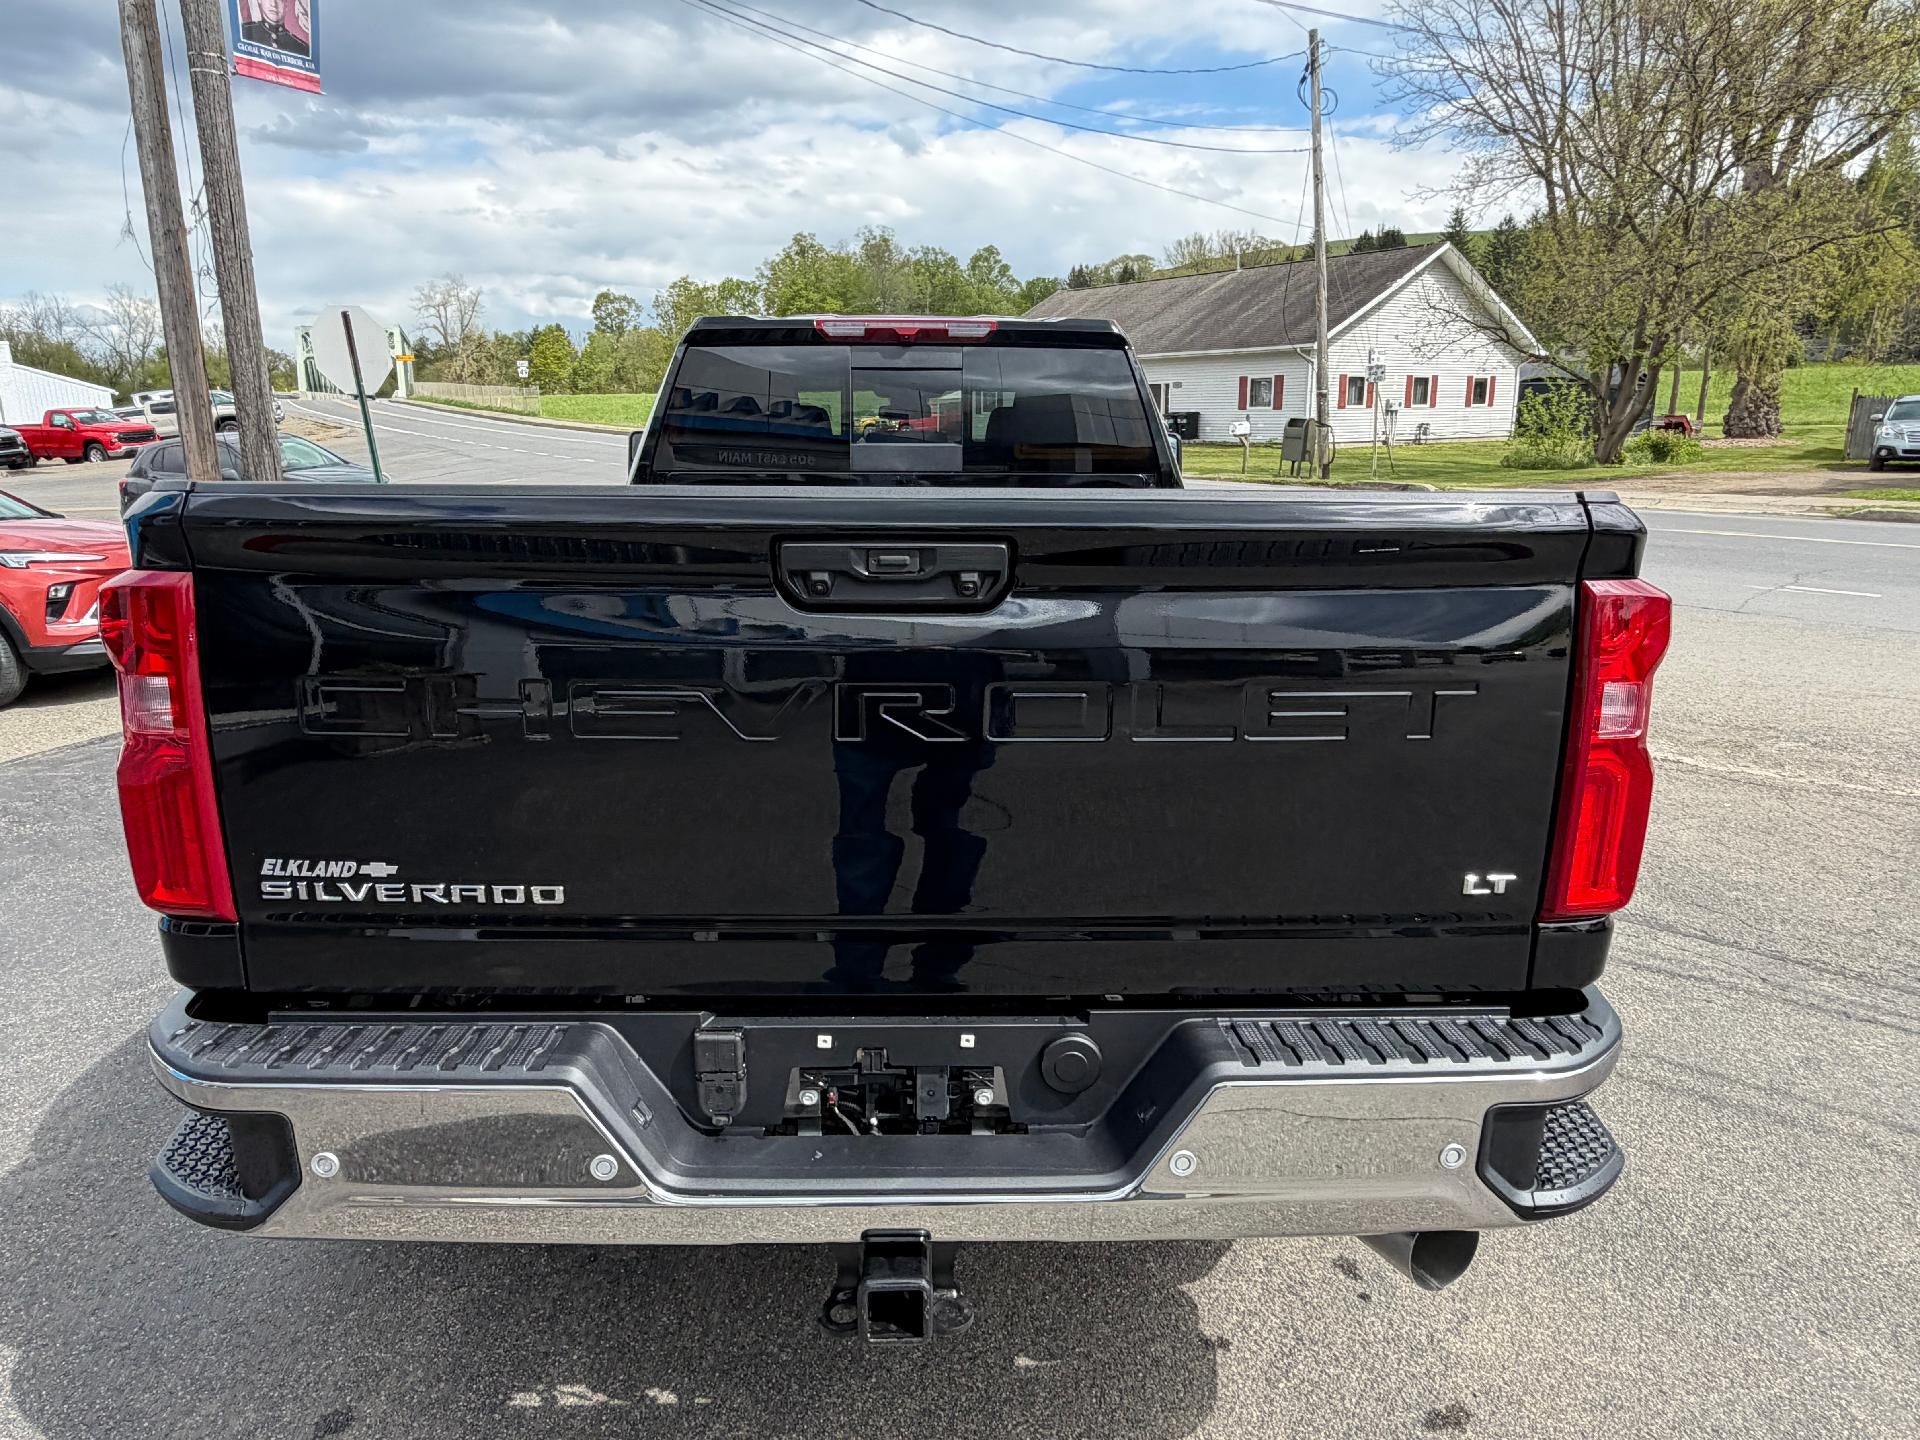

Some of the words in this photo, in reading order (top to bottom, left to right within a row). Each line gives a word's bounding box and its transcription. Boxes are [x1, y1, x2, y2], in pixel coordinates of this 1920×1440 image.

[302, 677, 1479, 742] CHEVROLET
[261, 858, 357, 878] ELKLAND
[261, 881, 565, 904] SILVERADO
[1463, 873, 1517, 895] LT
